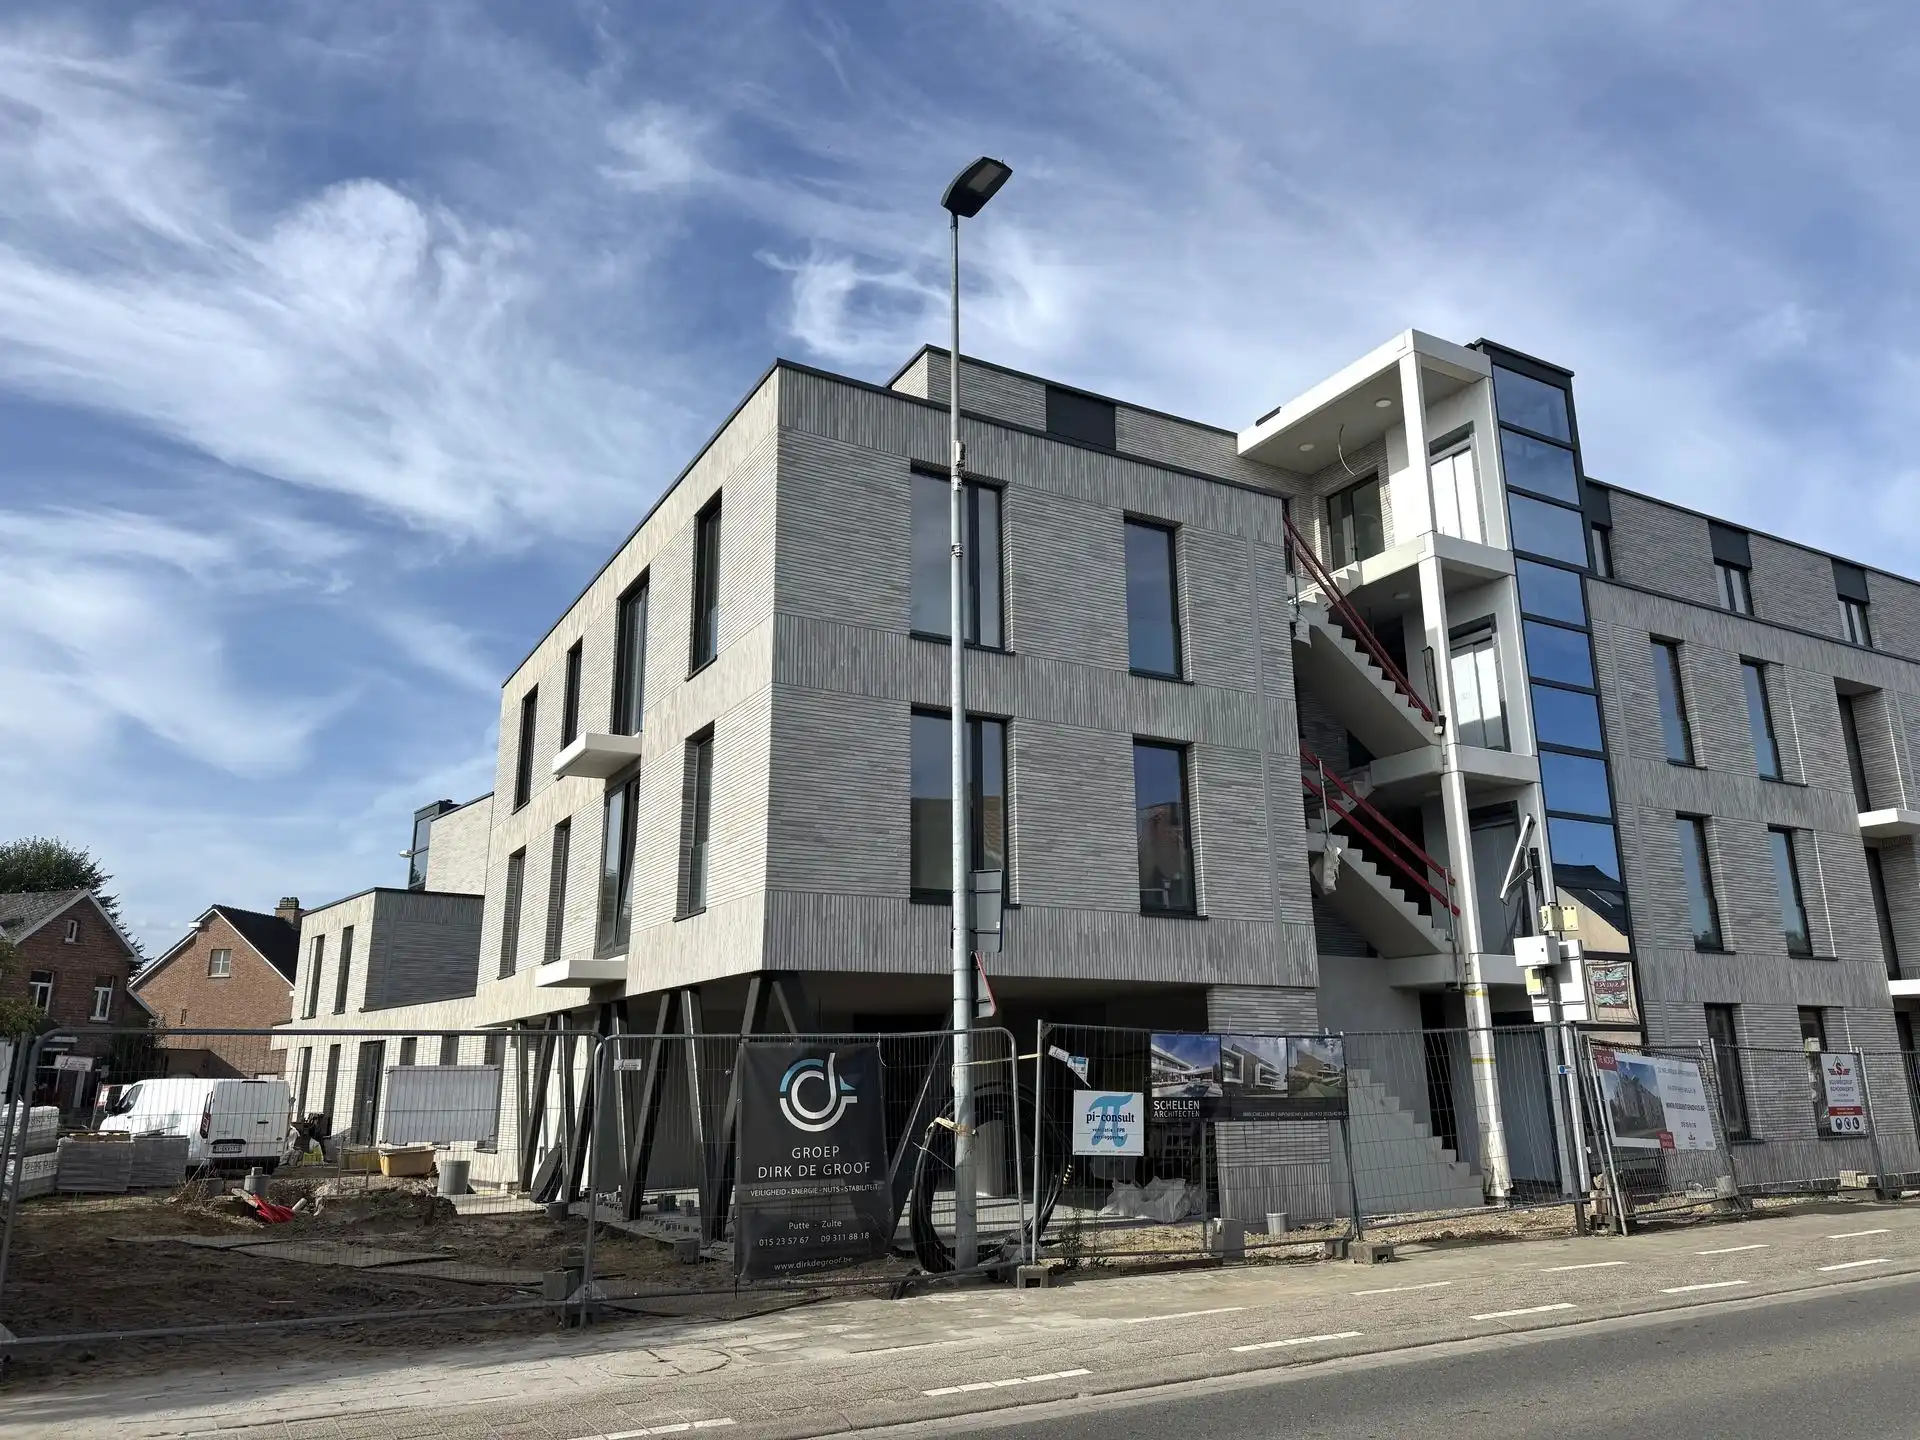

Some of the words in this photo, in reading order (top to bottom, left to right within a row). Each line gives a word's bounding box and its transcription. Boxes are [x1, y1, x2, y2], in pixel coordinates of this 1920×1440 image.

[1153, 1100, 1200, 1110] SCHELLEN
[1086, 1112, 1135, 1124] pi-consult
[1153, 1110, 1200, 1118] ARCHITECTEN
[791, 1145, 840, 1159] GROEP
[758, 1165, 792, 1178] DIRK
[798, 1164, 816, 1177] DE
[823, 1162, 871, 1175] GROOF
[750, 1188, 787, 1197] VEILIGHEID
[791, 1187, 818, 1195] ENERGIE
[822, 1185, 840, 1194] NUTS
[844, 1183, 878, 1192] STABILITEIT
[788, 1221, 810, 1230] Putte
[821, 1219, 842, 1228] Zulte
[759, 1237, 774, 1246] 015
[775, 1236, 786, 1246] 23
[787, 1236, 798, 1245] 57
[799, 1235, 809, 1245] 67
[820, 1234, 831, 1243] 09
[832, 1233, 847, 1242] 311
[848, 1232, 858, 1241] 88
[774, 1256, 853, 1271] www.dirkdegroof.be
